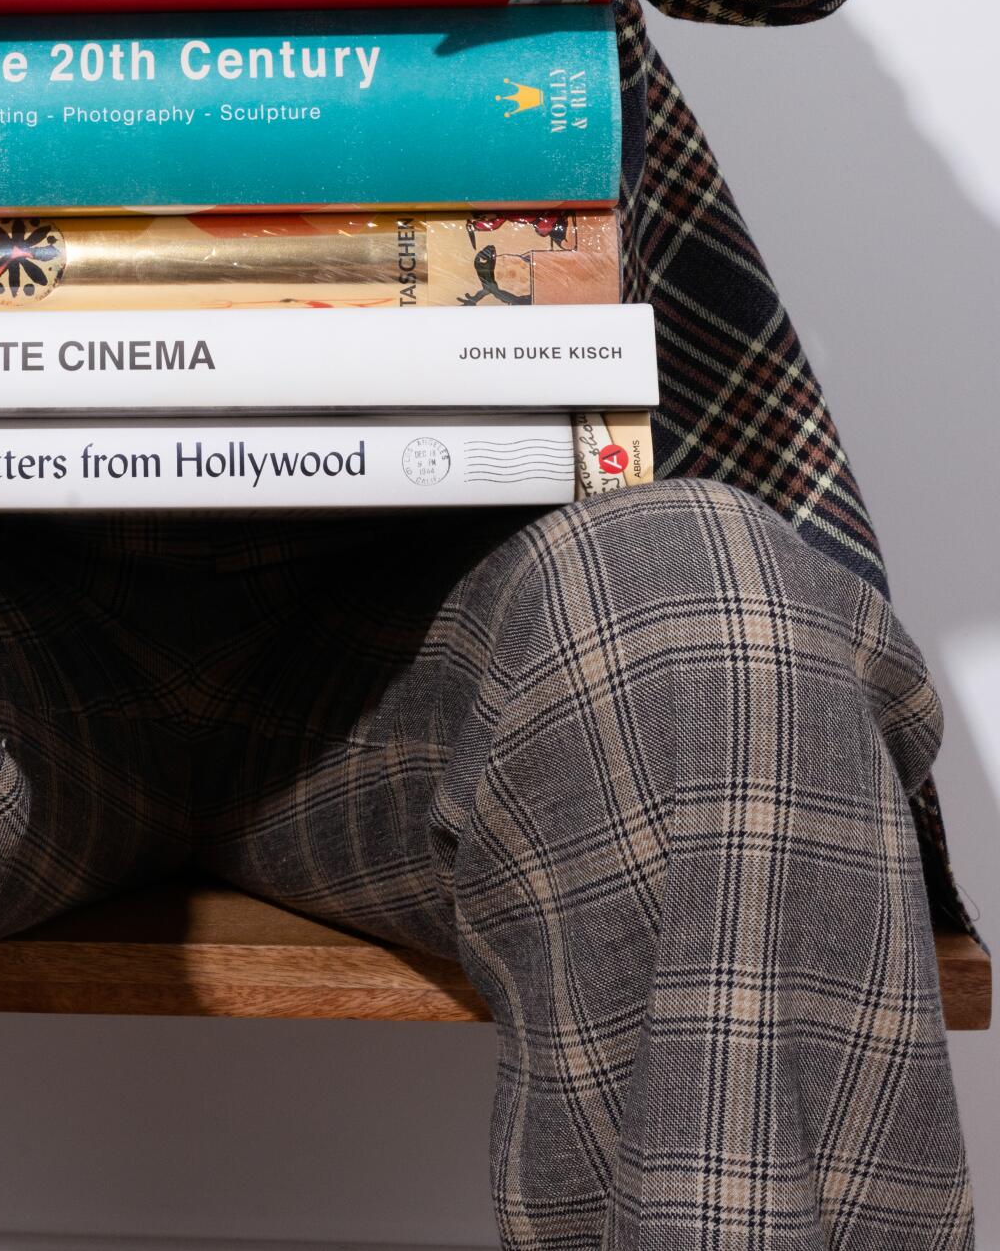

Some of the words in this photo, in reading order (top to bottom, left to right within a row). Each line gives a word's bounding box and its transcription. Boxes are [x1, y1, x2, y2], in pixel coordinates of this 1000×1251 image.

[49, 42, 155, 82] 20th
[180, 40, 380, 89] Century
[549, 68, 568, 133] MOLLY
[569, 70, 587, 108] REX
[63, 106, 195, 126] Photography
[221, 104, 321, 123] Sculpture
[571, 116, 588, 130] &
[396, 218, 417, 307] TASCHEN
[58, 340, 216, 372] CINEMA
[459, 347, 506, 360] JOHN
[513, 346, 562, 360] DUKE
[569, 346, 622, 360] KISCH
[80, 443, 161, 479] from
[176, 440, 366, 488] Hollywood
[632, 439, 642, 479] ABRAMS
